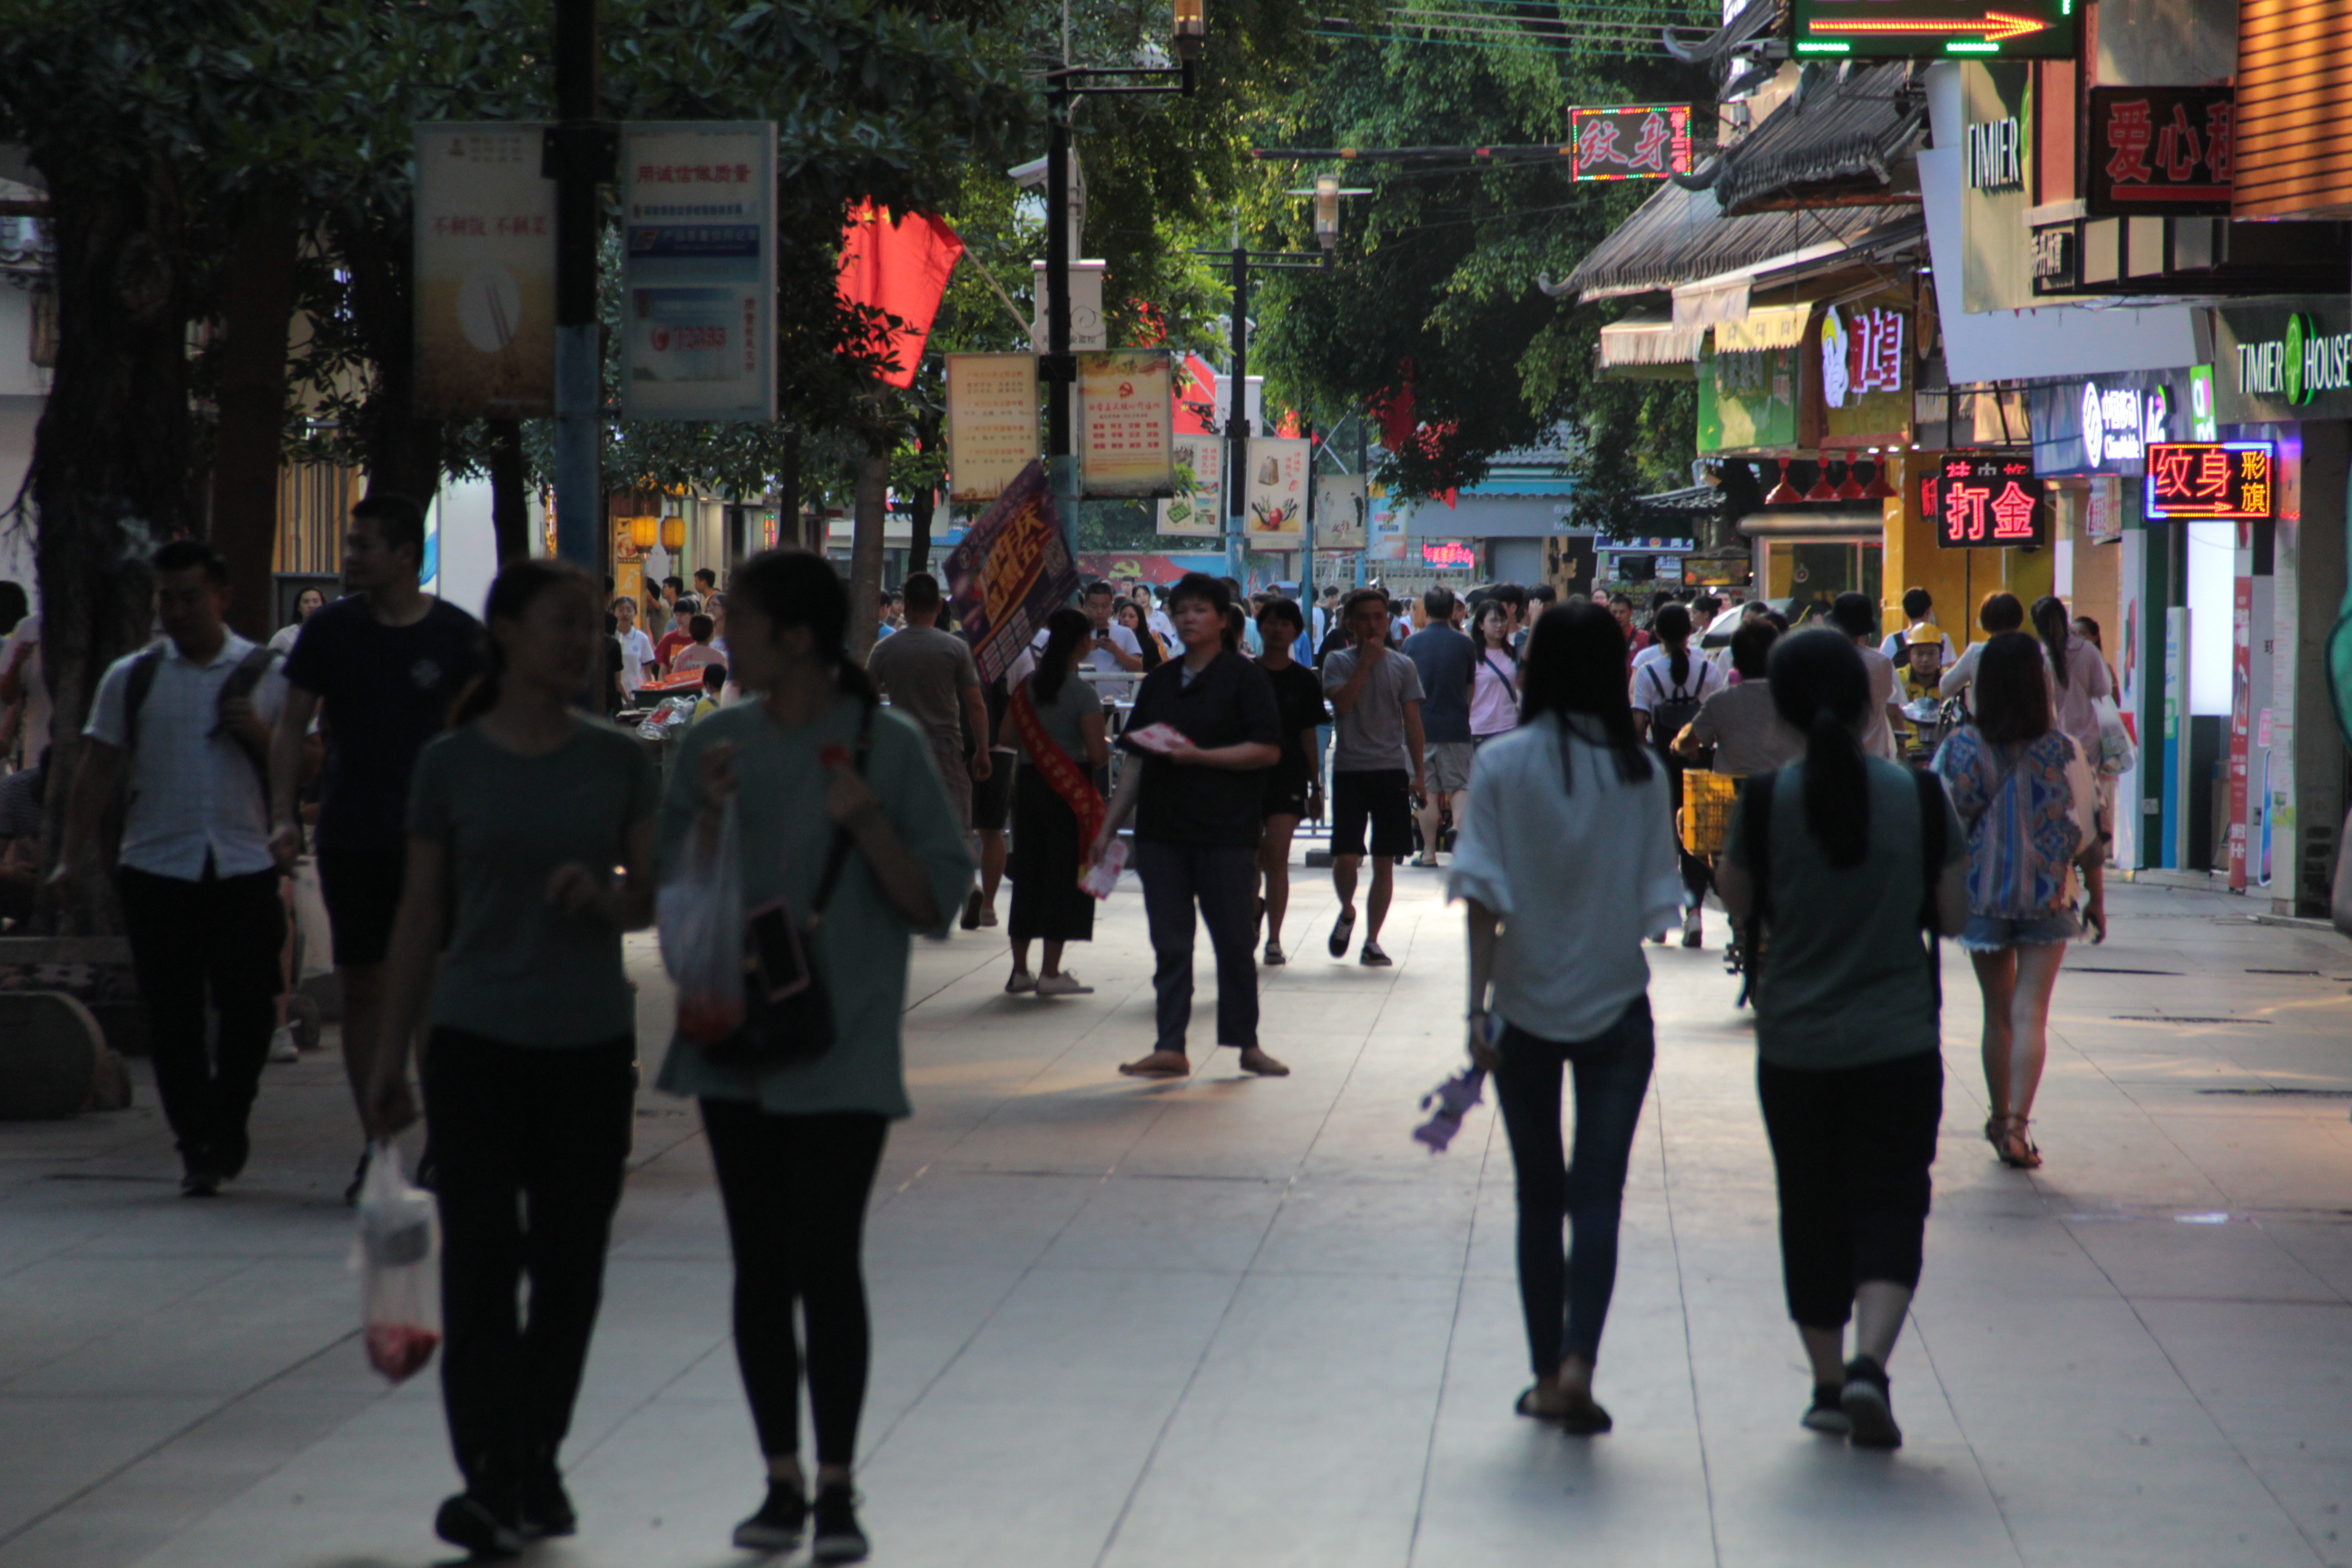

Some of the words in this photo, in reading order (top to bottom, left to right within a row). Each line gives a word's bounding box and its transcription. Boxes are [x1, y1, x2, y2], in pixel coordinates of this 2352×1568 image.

[1579, 112, 1671, 172] 纹身
[1042, 335, 1096, 344] 天安监控
[2237, 340, 2284, 394] TIMIER
[2305, 333, 2352, 390] HOUSE
[2102, 389, 2138, 430] 中国移动
[2154, 448, 2232, 497] 纹身
[2241, 450, 2266, 512] 彩旗
[1945, 481, 2035, 540] 打金
